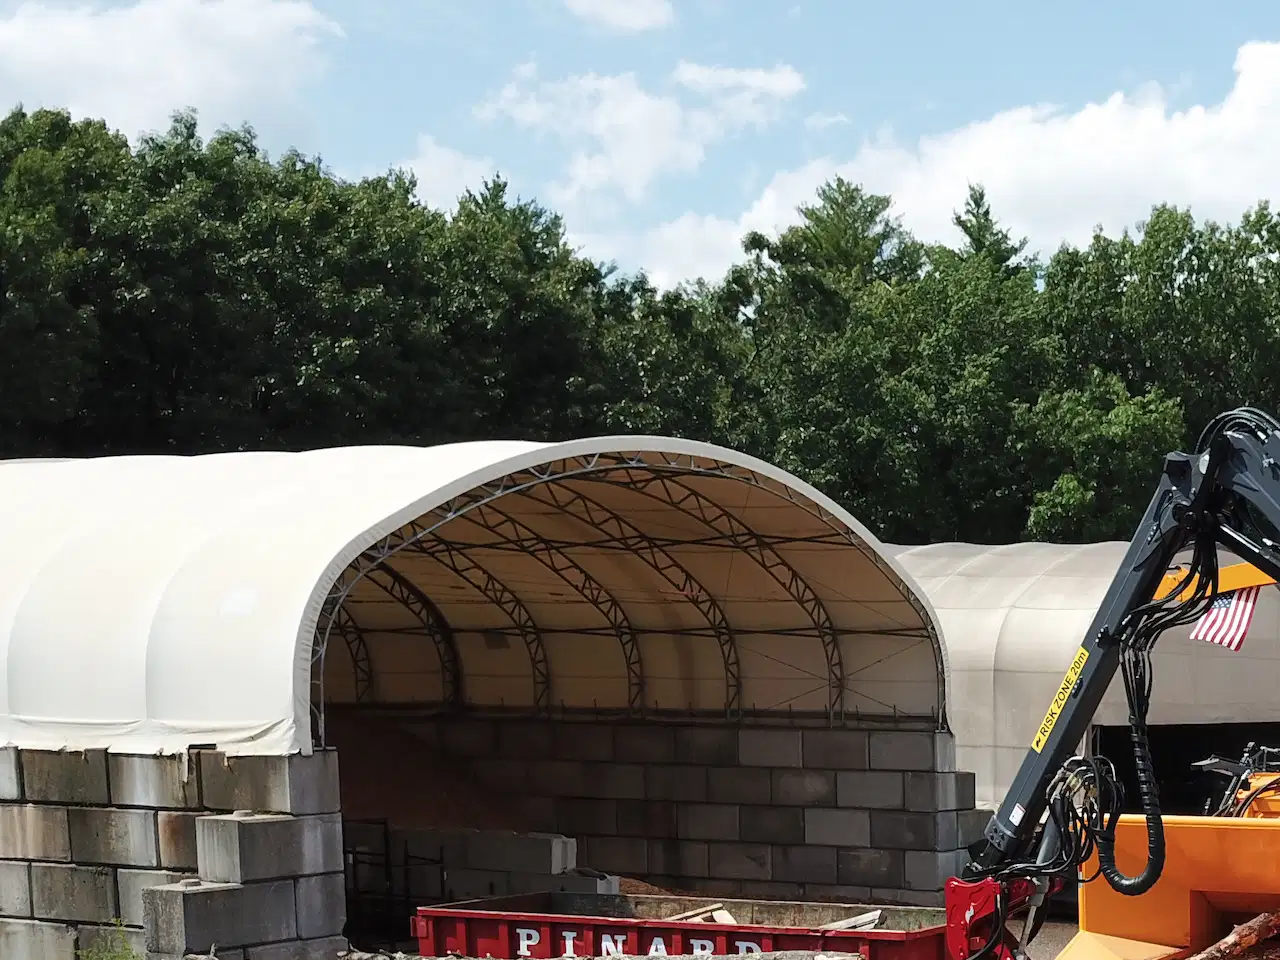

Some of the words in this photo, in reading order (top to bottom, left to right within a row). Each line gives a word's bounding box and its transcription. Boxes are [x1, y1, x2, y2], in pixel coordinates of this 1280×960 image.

[1040, 708, 1057, 737] RISK
[1053, 676, 1074, 709] ZONE
[1070, 652, 1086, 676] 20m
